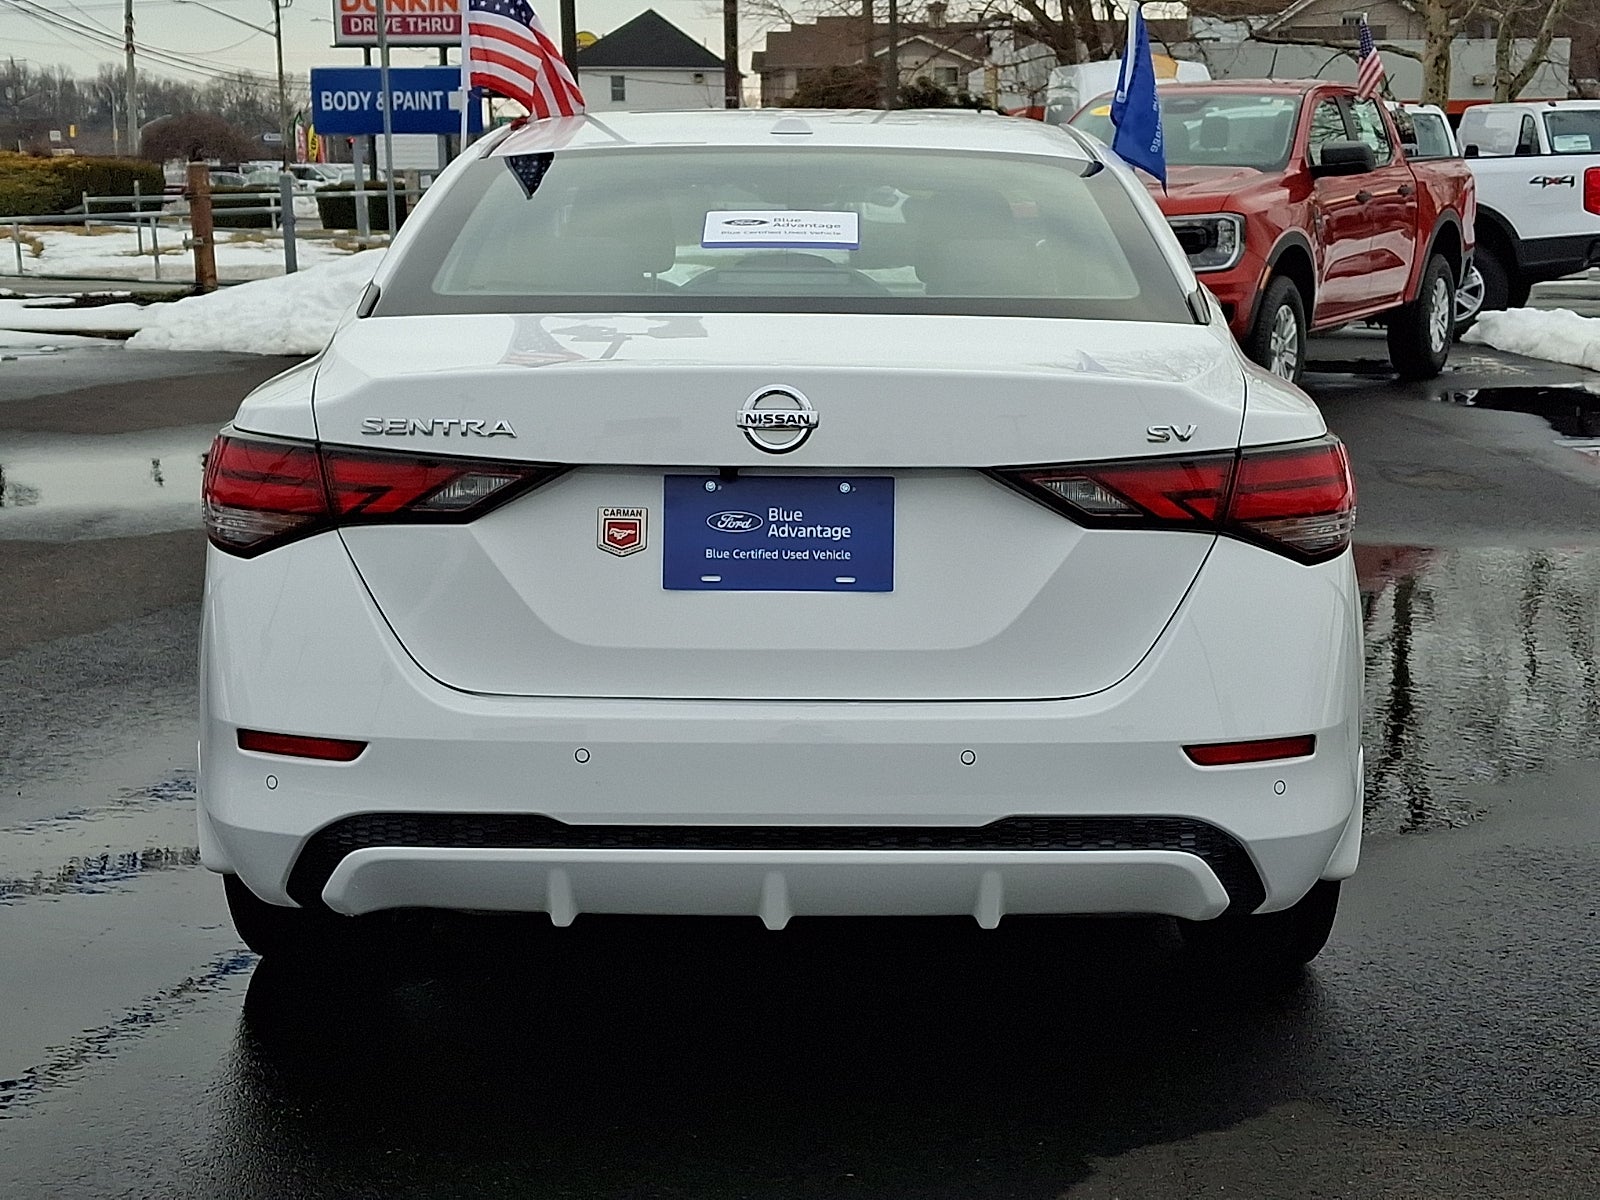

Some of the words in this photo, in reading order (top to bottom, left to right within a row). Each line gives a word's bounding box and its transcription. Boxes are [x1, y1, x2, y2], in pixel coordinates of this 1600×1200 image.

[341, 0, 459, 12] DNKIN
[406, 17, 455, 32] THRU
[320, 91, 372, 111] BODY
[392, 91, 444, 111] PAINT
[745, 413, 810, 425] NISSAN
[360, 417, 518, 439] SENTRA
[1146, 424, 1198, 443] SV
[603, 508, 643, 517] CARMAN
[768, 507, 803, 522] Blue
[717, 513, 752, 529] Ford
[767, 523, 852, 541] Advantage
[705, 548, 729, 559] Blue
[732, 548, 779, 559] Certified
[782, 549, 810, 560] Used
[812, 549, 851, 560] Vehicle
